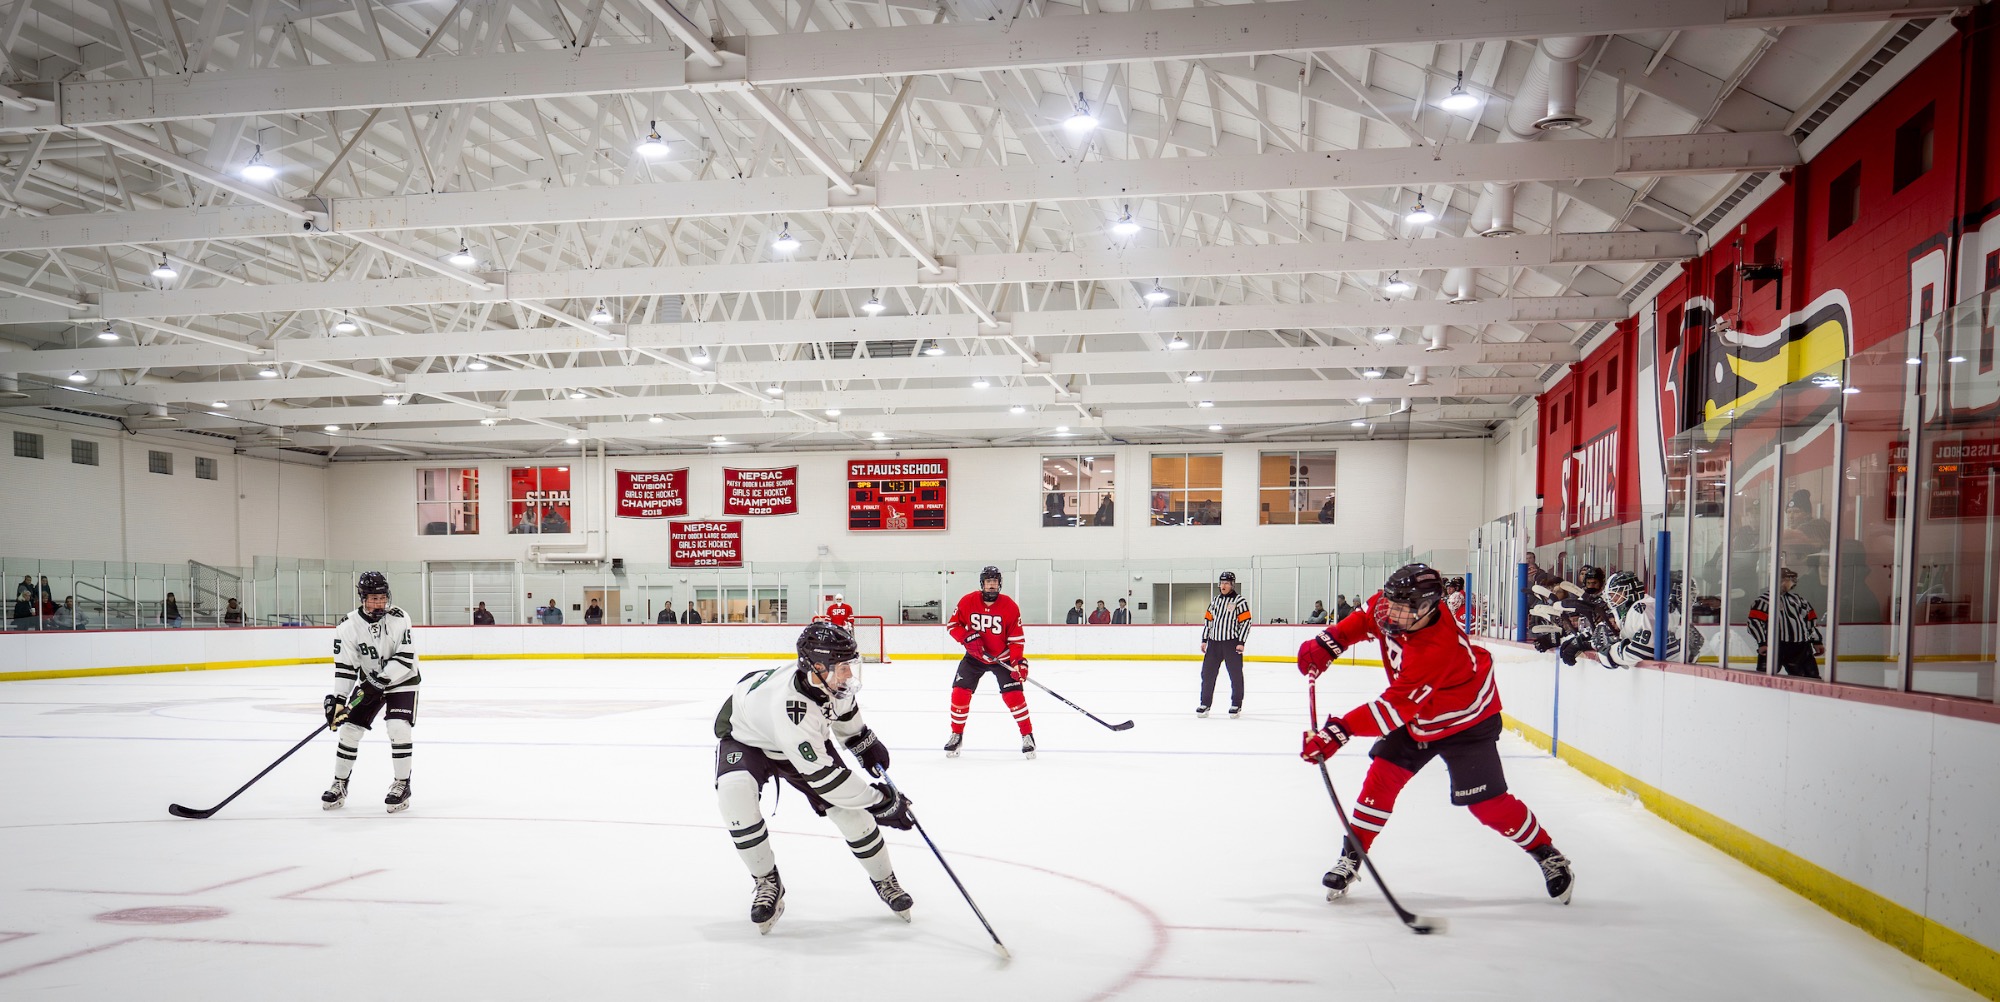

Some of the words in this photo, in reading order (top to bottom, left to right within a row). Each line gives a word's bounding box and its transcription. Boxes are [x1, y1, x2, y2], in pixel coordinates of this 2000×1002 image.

[851, 464, 866, 476] ST.
[867, 464, 901, 475] PAUL'S
[902, 463, 943, 475] SCHOOL
[630, 473, 674, 482] NEPSAC
[738, 471, 783, 480] NEPSAC
[776, 479, 794, 487] SCHOOL
[857, 481, 871, 489] SPS
[888, 481, 912, 491] 4:31
[625, 490, 643, 499] GIRLS
[644, 490, 654, 499] ICE
[655, 489, 679, 499] HOCKEY
[732, 488, 750, 497] GIRLS
[752, 489, 762, 497] ICE
[763, 487, 788, 497] HOCKEY
[621, 497, 683, 508] CHAMPIONS
[729, 496, 792, 507] CHAMPIONS
[683, 523, 727, 532] NEPSAC
[678, 540, 696, 549] GIRLS
[697, 540, 707, 549] ICE
[708, 540, 733, 549] HOCKEY
[675, 549, 736, 558] CHAMPIONS
[694, 558, 717, 566] 2023
[832, 608, 846, 616] SPS
[970, 612, 1002, 635] SPS
[1632, 629, 1652, 645] 29
[1407, 684, 1433, 704] 17
[798, 741, 818, 763] 8
